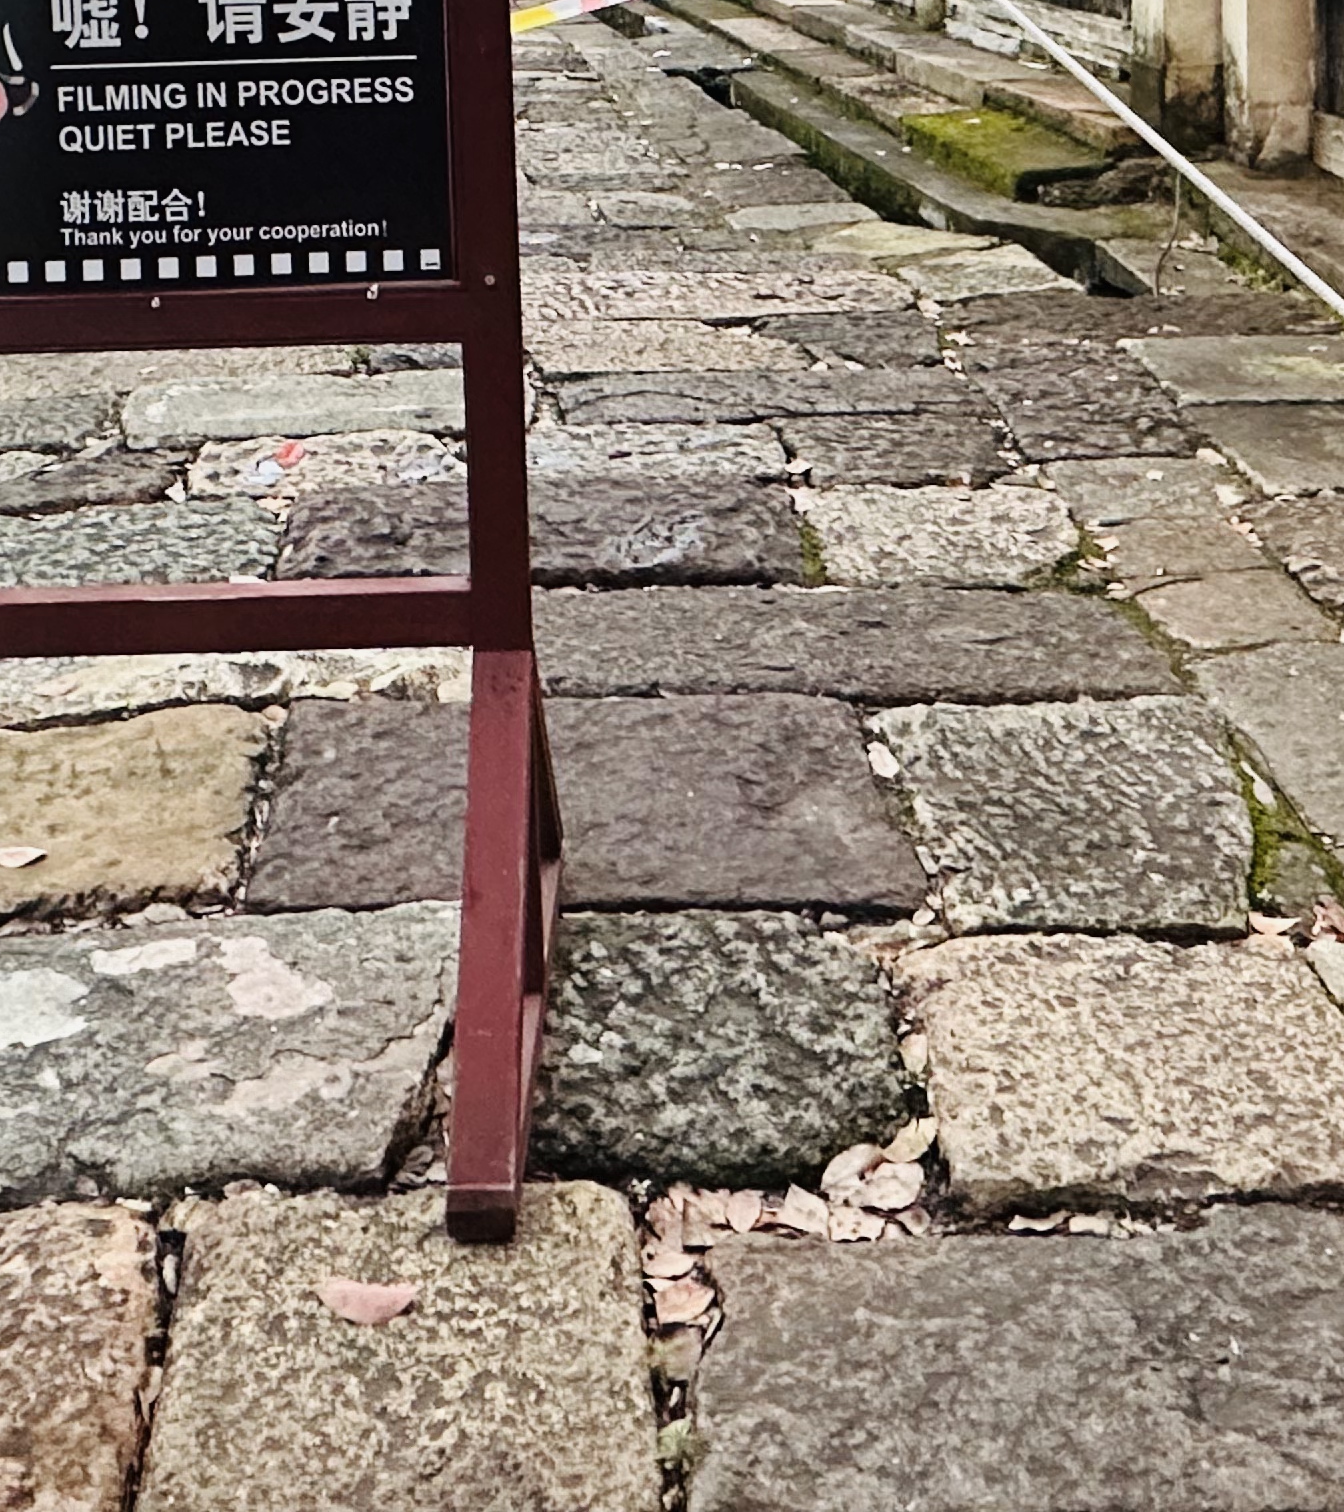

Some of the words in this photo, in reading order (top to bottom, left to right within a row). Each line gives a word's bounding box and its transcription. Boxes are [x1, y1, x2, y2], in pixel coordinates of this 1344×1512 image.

[57, 83, 187, 112] FILMING
[197, 82, 227, 108] IN
[238, 76, 415, 107] PROGRESS
[59, 124, 155, 152] QUIET
[166, 120, 291, 149] PLEASE
[60, 188, 206, 224] 谢谢配合！
[60, 227, 123, 246] Thank
[129, 231, 166, 249] you
[173, 225, 201, 245] for
[207, 227, 253, 248] your
[258, 219, 388, 243] cooperation!
